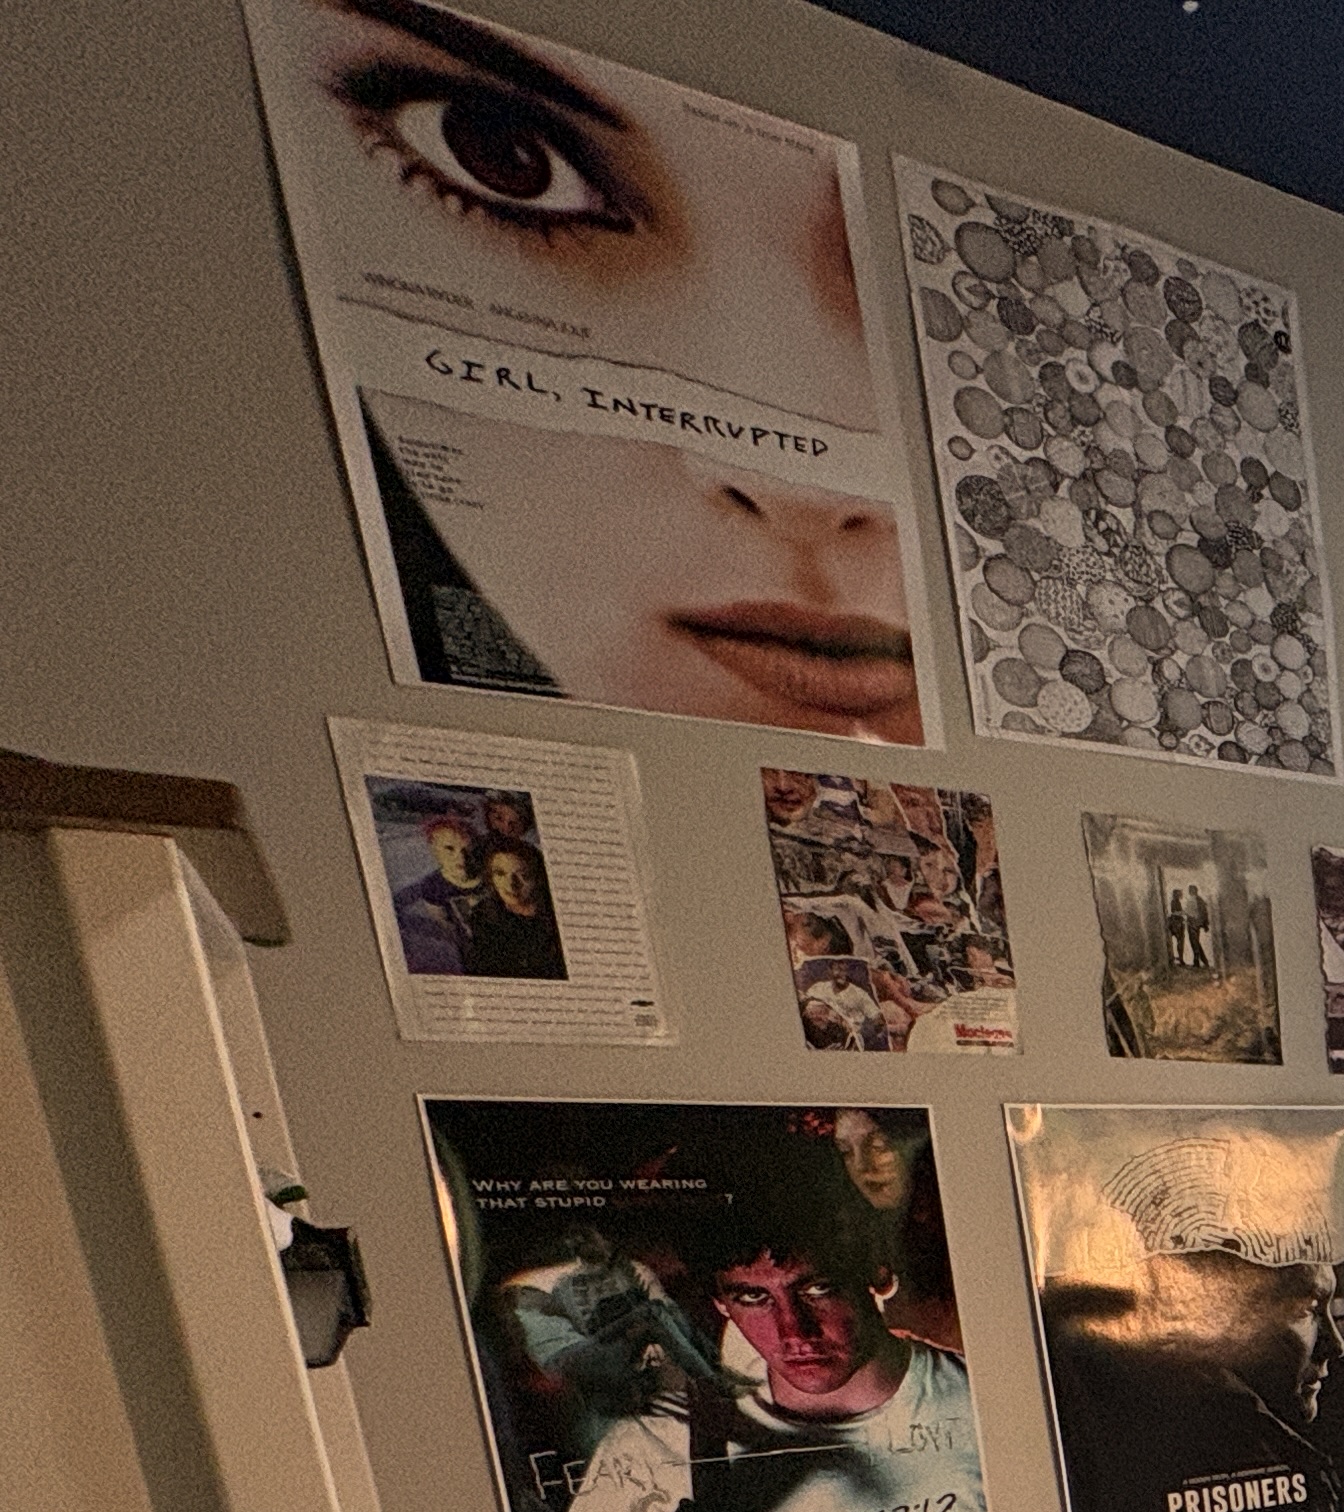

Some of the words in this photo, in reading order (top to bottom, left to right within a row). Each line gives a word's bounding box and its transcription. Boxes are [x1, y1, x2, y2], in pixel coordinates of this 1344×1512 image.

[425, 349, 561, 402] GIRL,
[582, 386, 829, 458] INTERRUPTED
[472, 1179, 522, 1192] WHY
[529, 1179, 569, 1191] ARE
[573, 1179, 613, 1191] YOU
[618, 1178, 708, 1191] WEARING
[476, 1197, 528, 1209] THAT
[535, 1196, 607, 1208] STUPID
